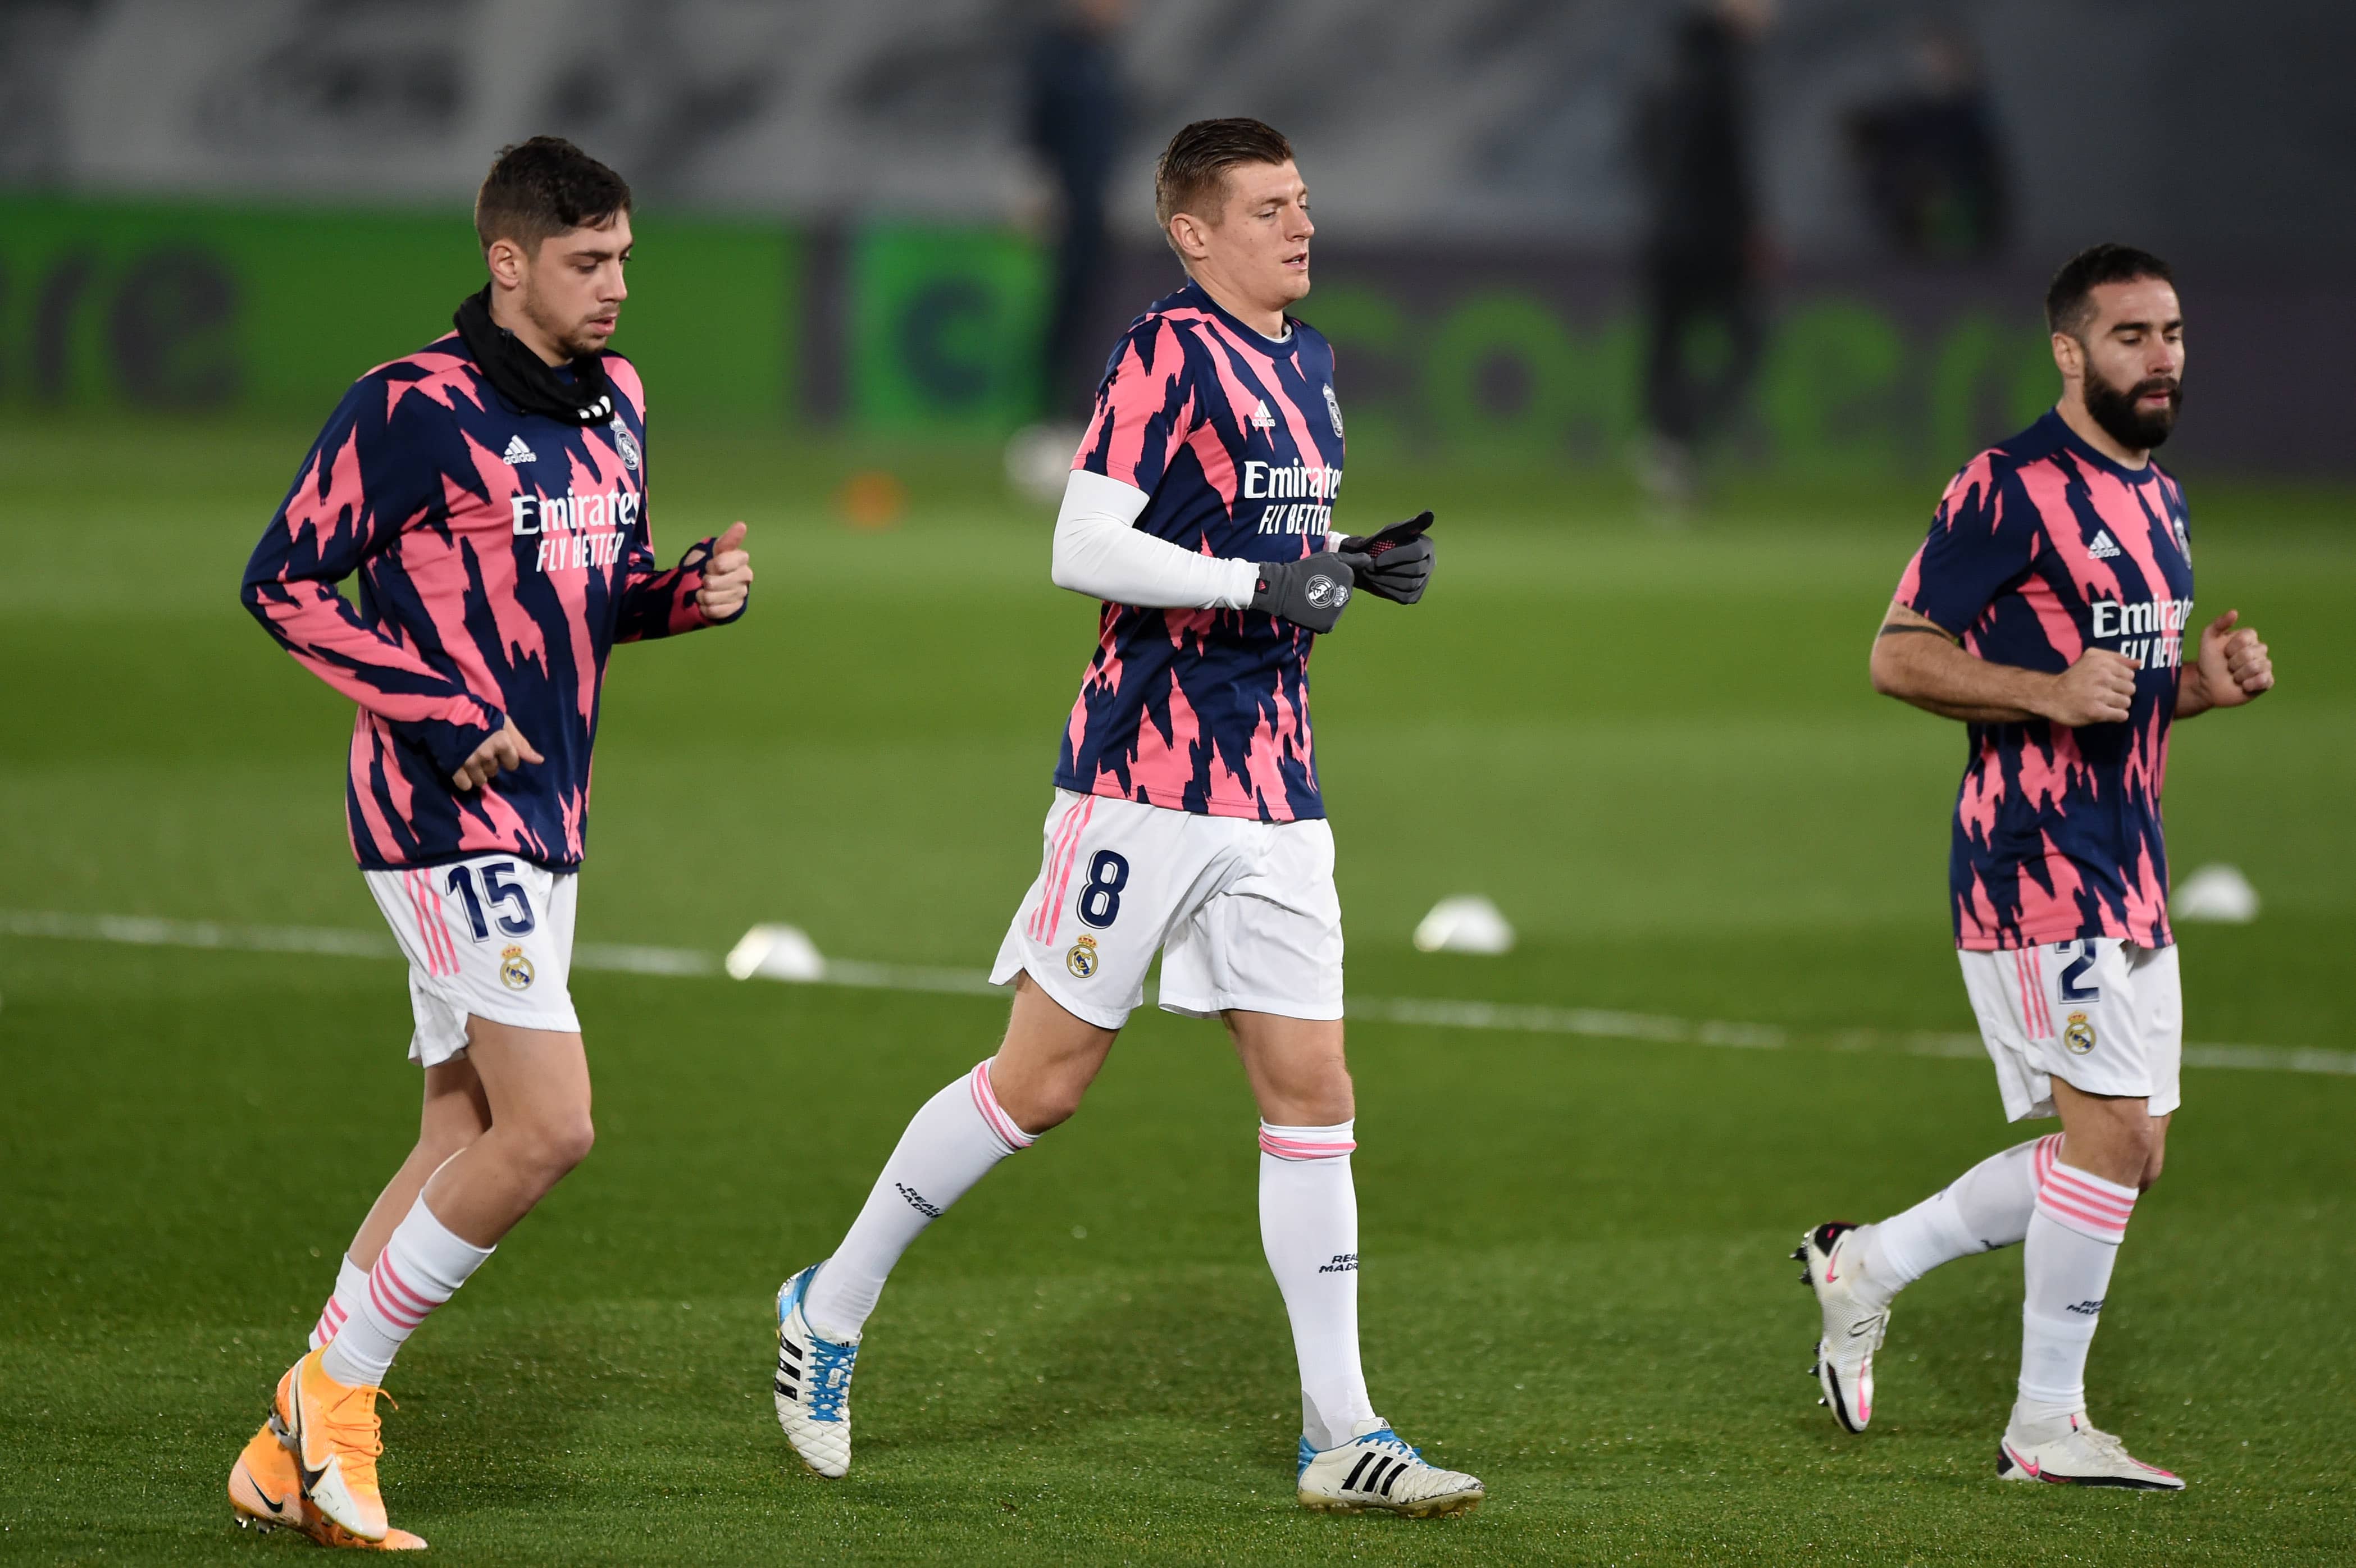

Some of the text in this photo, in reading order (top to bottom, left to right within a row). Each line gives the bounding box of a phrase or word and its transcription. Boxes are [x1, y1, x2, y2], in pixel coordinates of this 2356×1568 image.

[1252, 417, 1275, 427] adidas
[503, 452, 536, 465] adidas
[1257, 505, 1288, 535] FLY
[536, 531, 625, 572] FLY BETTER
[445, 862, 535, 943] 15
[1077, 850, 1129, 929] 8
[2054, 940, 2100, 1005] 2
[906, 1188, 940, 1214] REAL
[1319, 1262, 1358, 1273] MADR
